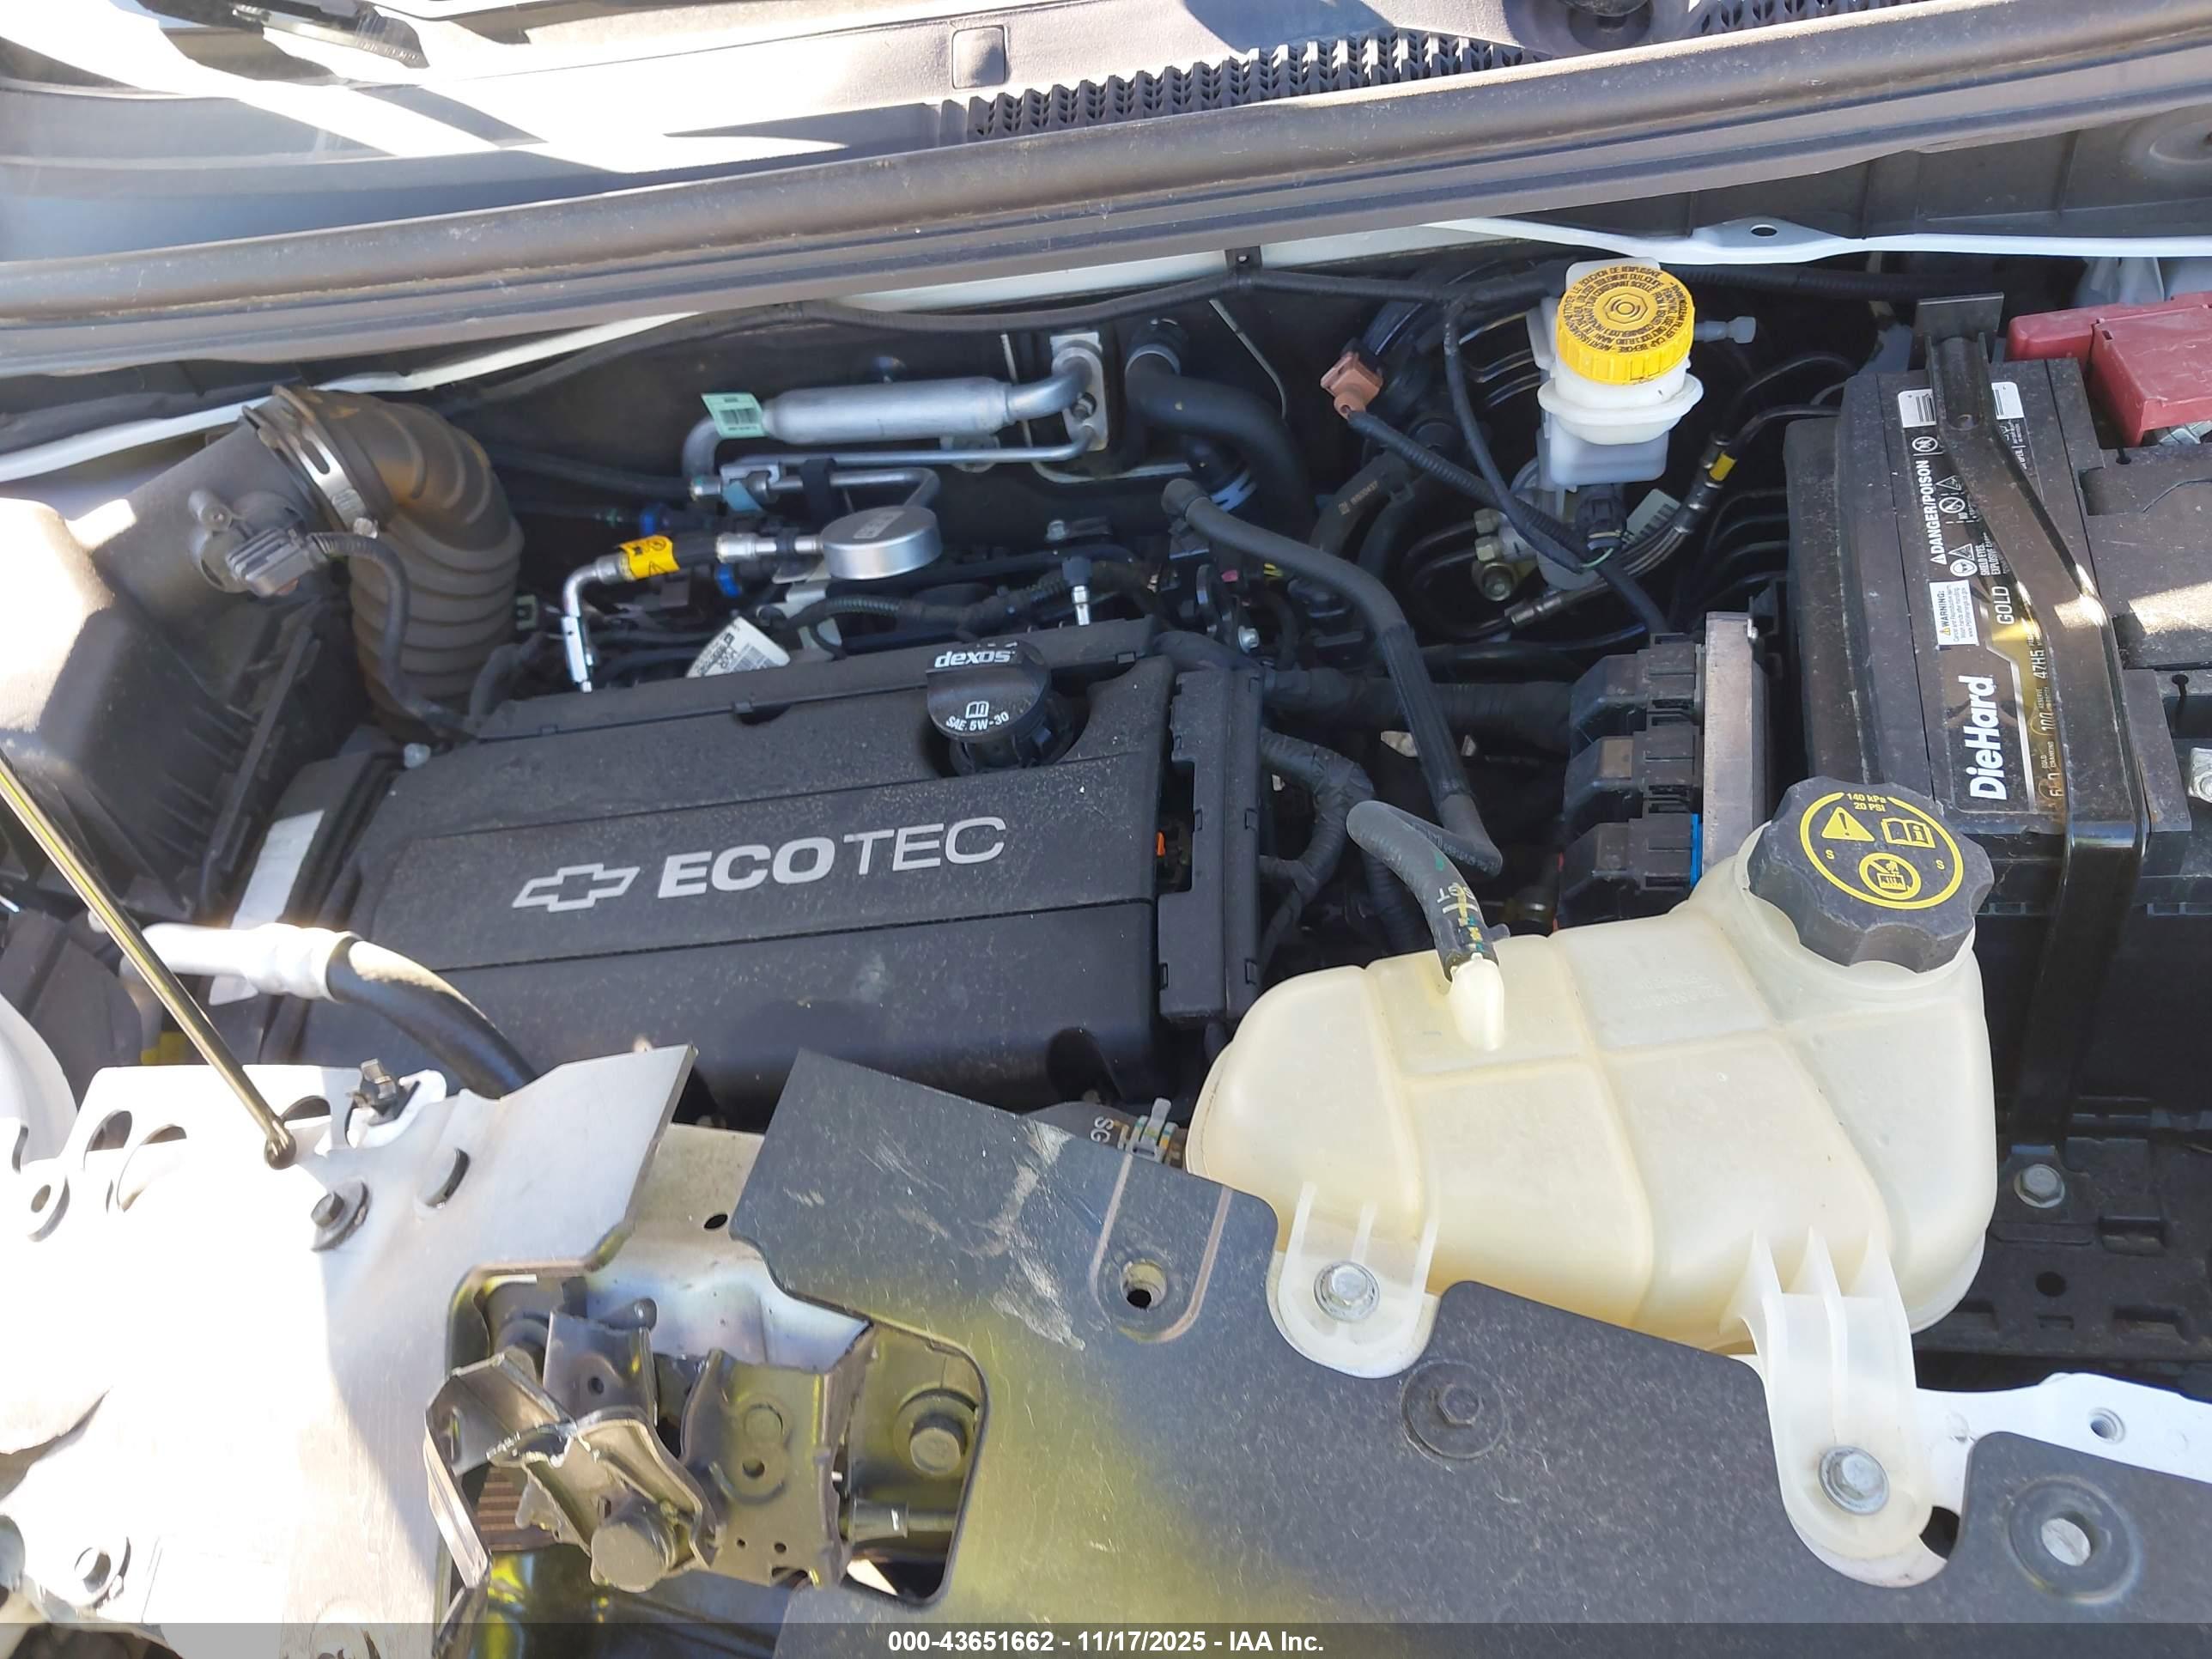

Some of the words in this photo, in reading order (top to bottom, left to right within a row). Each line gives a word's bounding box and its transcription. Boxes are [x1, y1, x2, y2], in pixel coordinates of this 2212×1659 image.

[1570, 285, 1581, 294] LE
[1648, 336, 1667, 348] CAP
[1916, 459, 1945, 555] DANGER/POISON
[1978, 558, 1990, 576] SHIELD
[1986, 548, 2001, 574] EXPLOSIVE
[1937, 591, 1950, 627] WARNING:
[1991, 586, 2014, 625] GOLD
[2030, 649, 2048, 679] 47H5
[945, 715, 967, 732] SAE
[969, 711, 1010, 732] 5W-30
[1958, 675, 2007, 800] DieHard
[1846, 793, 1865, 802] 140
[1866, 794, 1887, 805] kPa
[1853, 801, 1866, 811] 20
[1868, 803, 1887, 812] PSI
[658, 817, 1007, 899] ECOTEC
